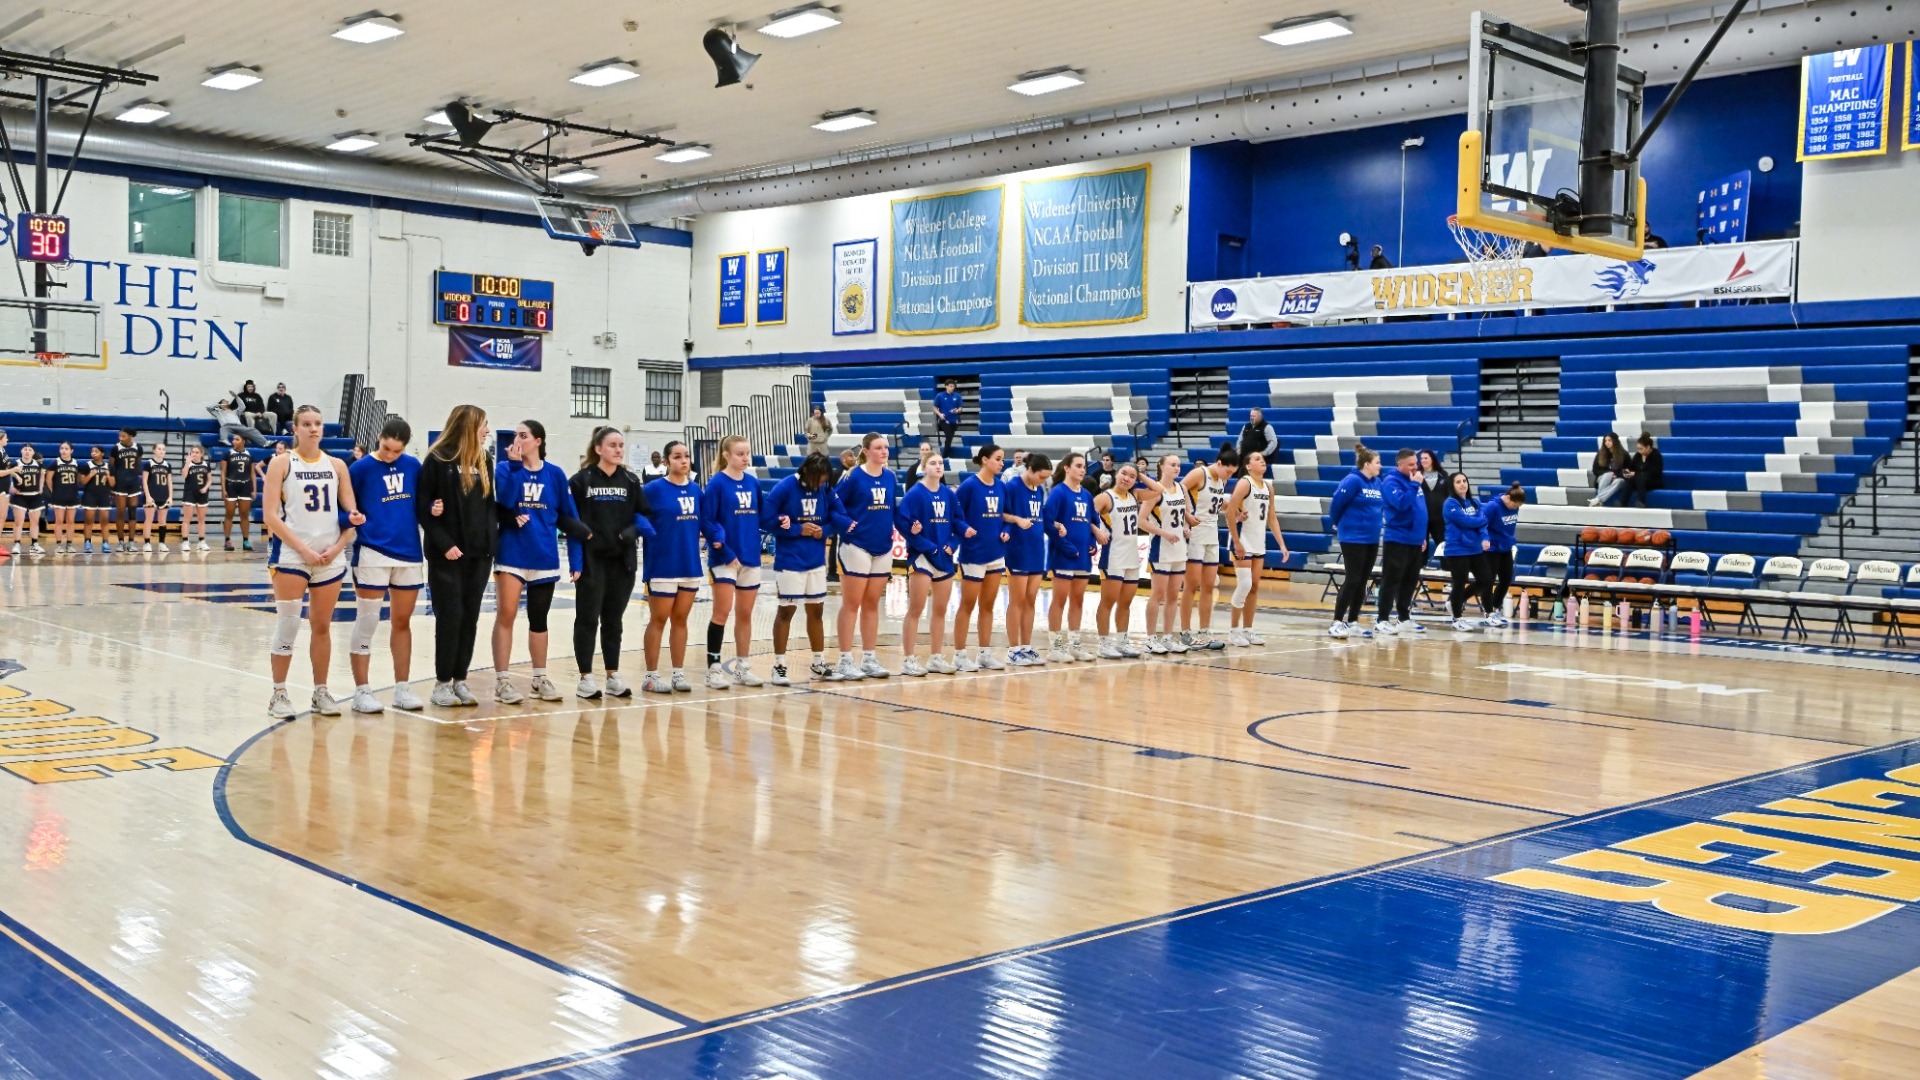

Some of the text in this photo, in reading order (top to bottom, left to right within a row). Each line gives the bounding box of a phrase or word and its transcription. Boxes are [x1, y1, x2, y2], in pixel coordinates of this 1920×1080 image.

[1833, 48, 1862, 68] W
[1828, 73, 1863, 84] FOOTBALL
[1830, 87, 1859, 101] MAC
[1812, 99, 1877, 114] CHAMPIONS
[1810, 121, 1875, 133] 1977 1978 1979
[1811, 116, 1828, 124] 1954
[1834, 114, 1852, 122] 1958
[1809, 130, 1875, 143] 1980 1981 1982
[1833, 142, 1851, 150] 1987
[1856, 140, 1874, 148] 1988
[1491, 149, 1552, 212] W
[1029, 192, 1138, 220] Widener University
[30, 218, 65, 234] 10:00
[905, 210, 987, 236] Widener College
[1034, 221, 1124, 246] NCAA Football
[32, 233, 60, 257] 30
[904, 236, 982, 261] NCAA Football
[728, 258, 740, 276] W
[765, 254, 778, 272] W
[1033, 251, 1130, 277] Division III 1981
[901, 264, 985, 288] Division III 1977
[70, 259, 198, 311] THE
[480, 276, 518, 296] 10:00
[1371, 267, 1534, 310] WIDENER
[1714, 284, 1762, 295] BSN SPORTS
[1028, 282, 1141, 307] National Champions
[459, 304, 469, 321] 0
[937, 294, 993, 317] Champions
[1213, 302, 1237, 313] NCAA
[1282, 298, 1320, 313] MAC
[537, 311, 547, 327] 0
[120, 313, 248, 363] DEN
[124, 458, 135, 469] 12
[237, 461, 245, 473] 3
[24, 474, 37, 486] 21
[61, 472, 75, 484] 20
[96, 475, 107, 486] 14
[156, 474, 167, 485] 10
[294, 471, 334, 480] WIDENER
[383, 473, 405, 495] W
[304, 484, 331, 512] 31
[523, 482, 544, 501] W
[870, 488, 887, 504] W
[677, 497, 695, 514] W
[735, 492, 752, 509] W
[801, 498, 818, 516] W
[985, 496, 999, 513] W
[1029, 500, 1041, 517] W
[932, 501, 946, 518] W
[1074, 502, 1088, 518] W
[1259, 502, 1266, 521] 3
[1123, 514, 1137, 536] 12
